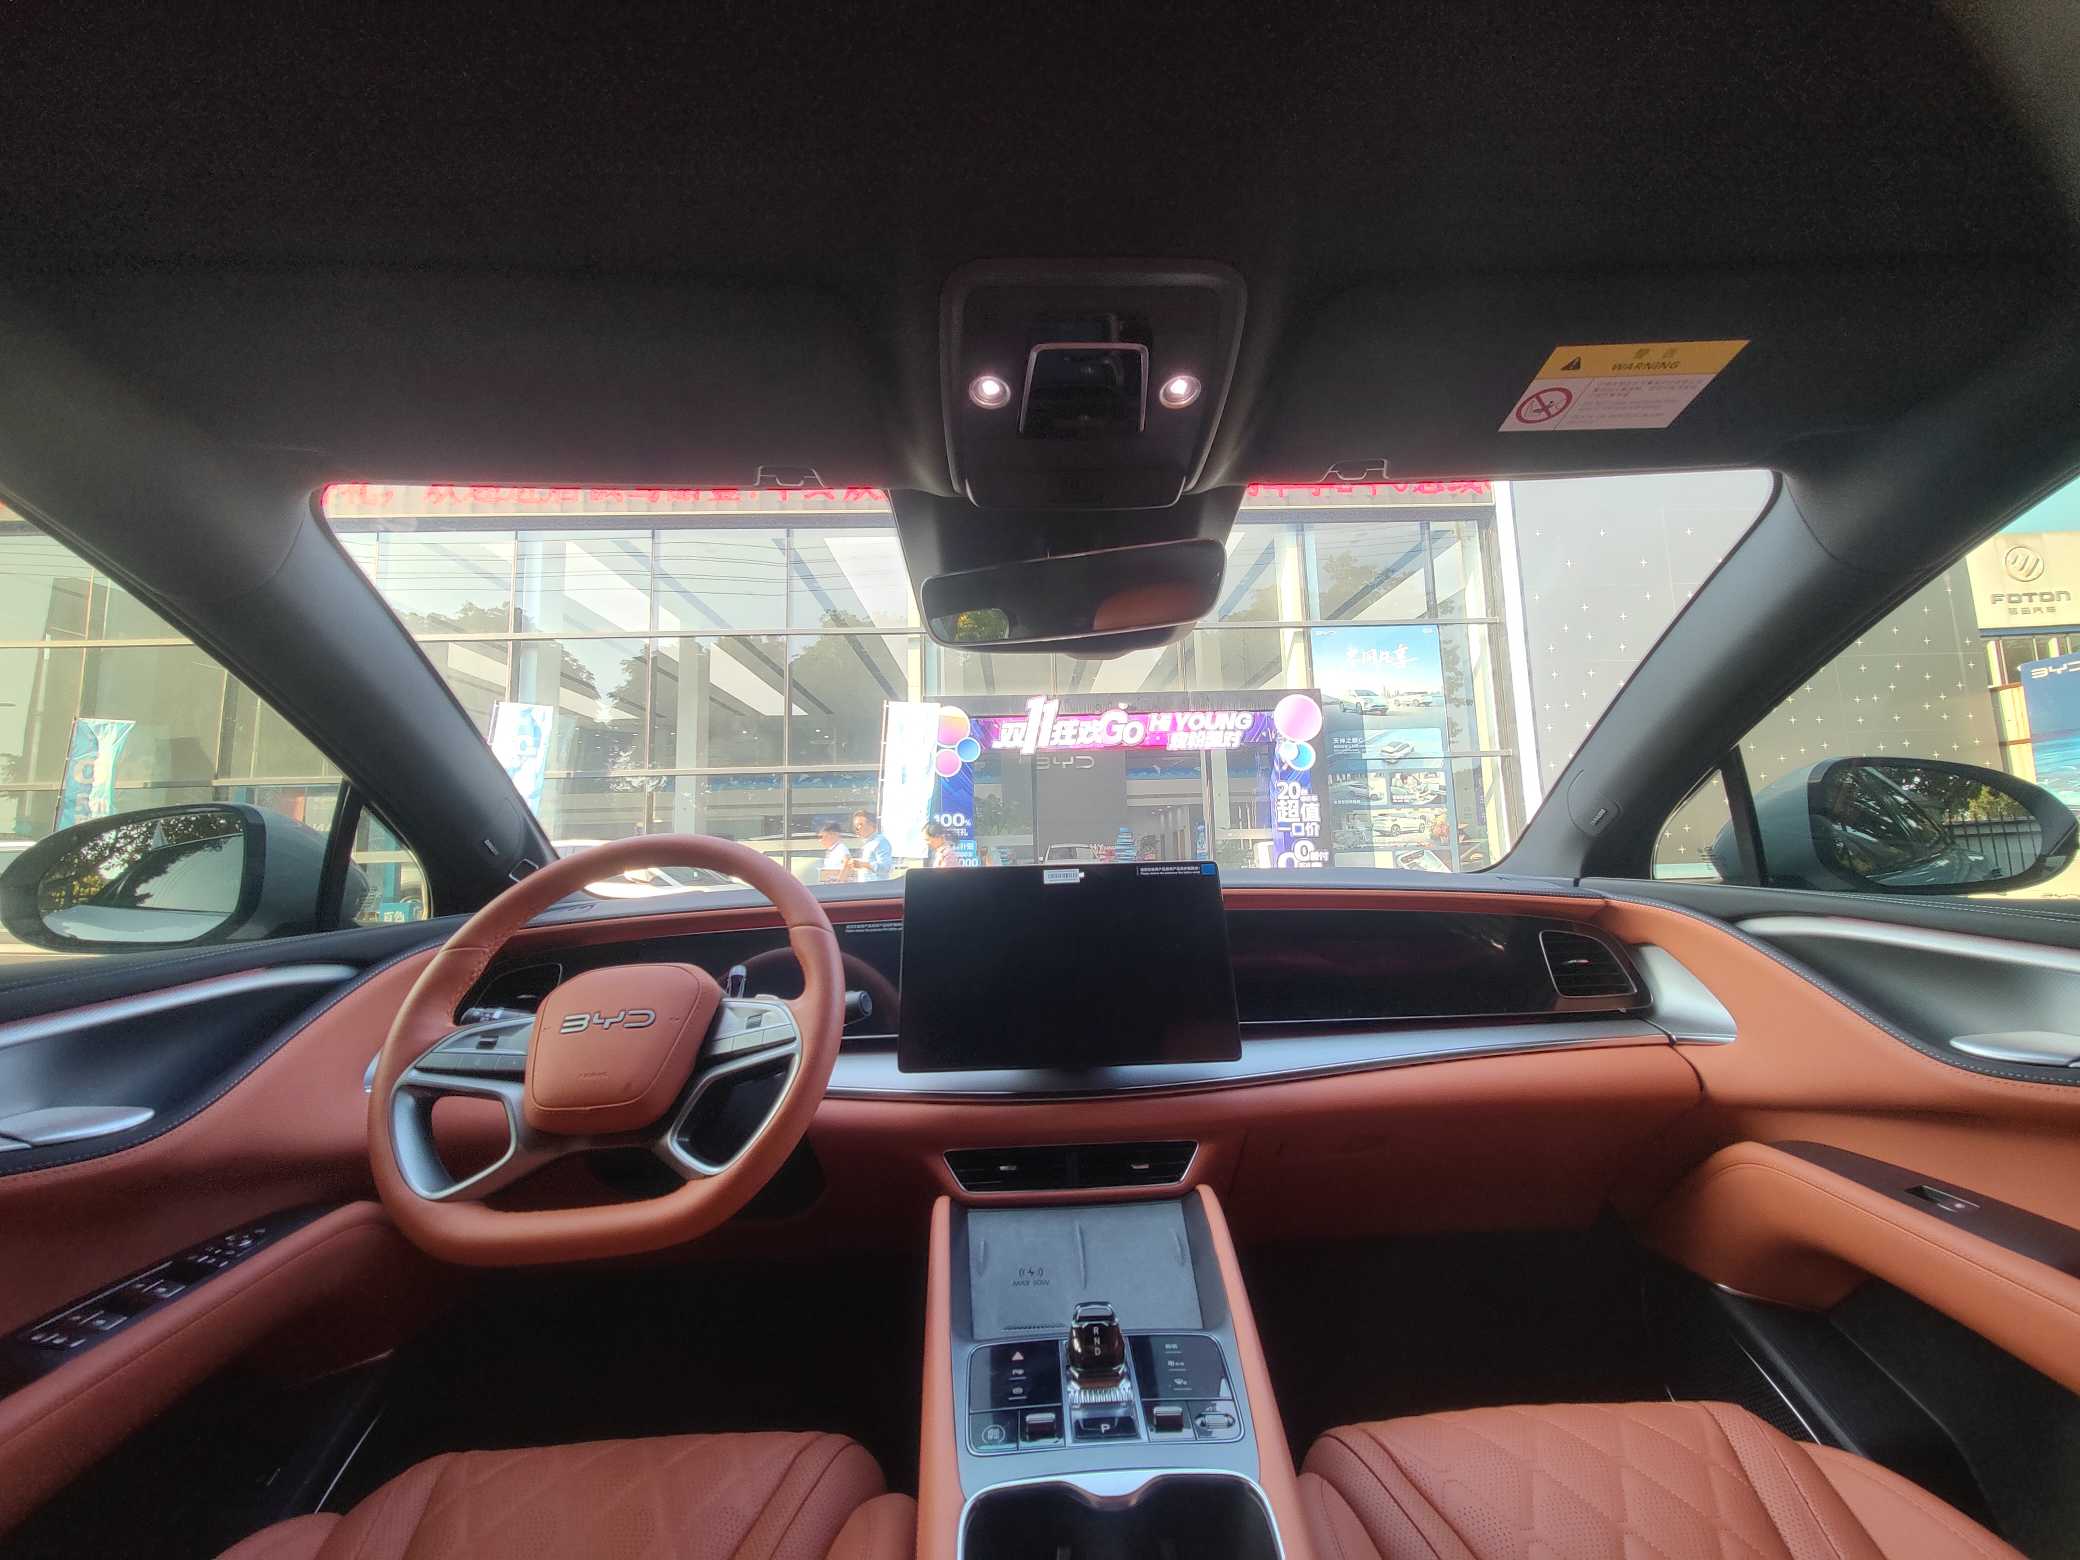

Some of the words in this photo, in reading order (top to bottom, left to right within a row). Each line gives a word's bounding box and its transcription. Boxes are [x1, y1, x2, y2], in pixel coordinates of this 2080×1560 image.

[1611, 359, 1680, 371] WARNING
[1991, 590, 2071, 605] FOTON
[1175, 711, 1254, 731] YOUNG
[1036, 756, 1096, 770] BYD
[1277, 801, 1321, 822] 超值
[1277, 822, 1321, 837] 一口价
[559, 1007, 657, 1035] BYD
[1100, 1423, 1111, 1434] P
